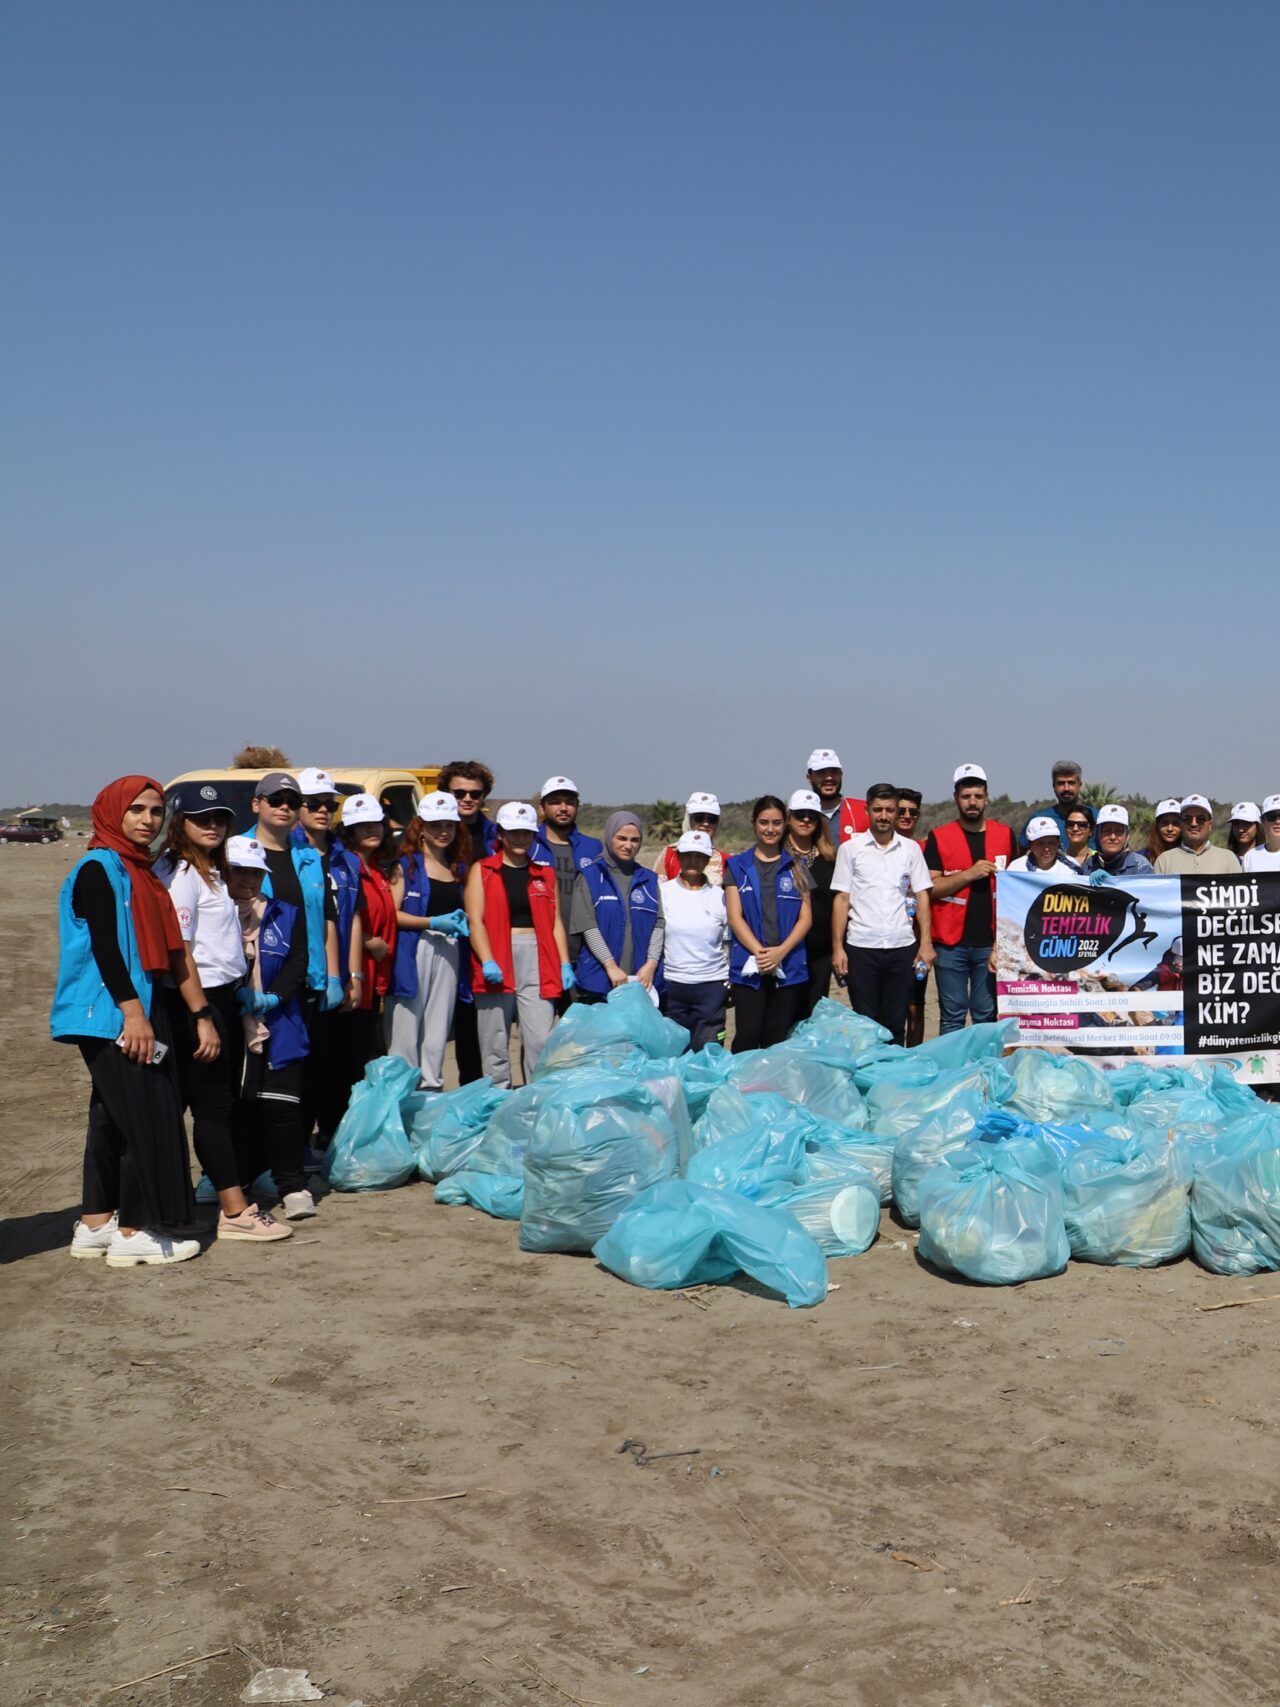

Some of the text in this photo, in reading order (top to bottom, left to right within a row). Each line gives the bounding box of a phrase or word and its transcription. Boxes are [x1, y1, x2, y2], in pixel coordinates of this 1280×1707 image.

[1043, 891, 1090, 913] DÜNYA
[1196, 878, 1259, 912] ŞİMDİ
[1041, 913, 1113, 935] TEMİZLİK
[1039, 935, 1078, 958] GÜNÜ
[1078, 939, 1099, 951] 2022
[1197, 943, 1225, 967] NE
[1006, 984, 1072, 993] Temizlik Noktası
[1198, 967, 1236, 995] BİZ
[1198, 996, 1251, 1025] KİM?
[1018, 1017, 1074, 1027] luşma Noktası
